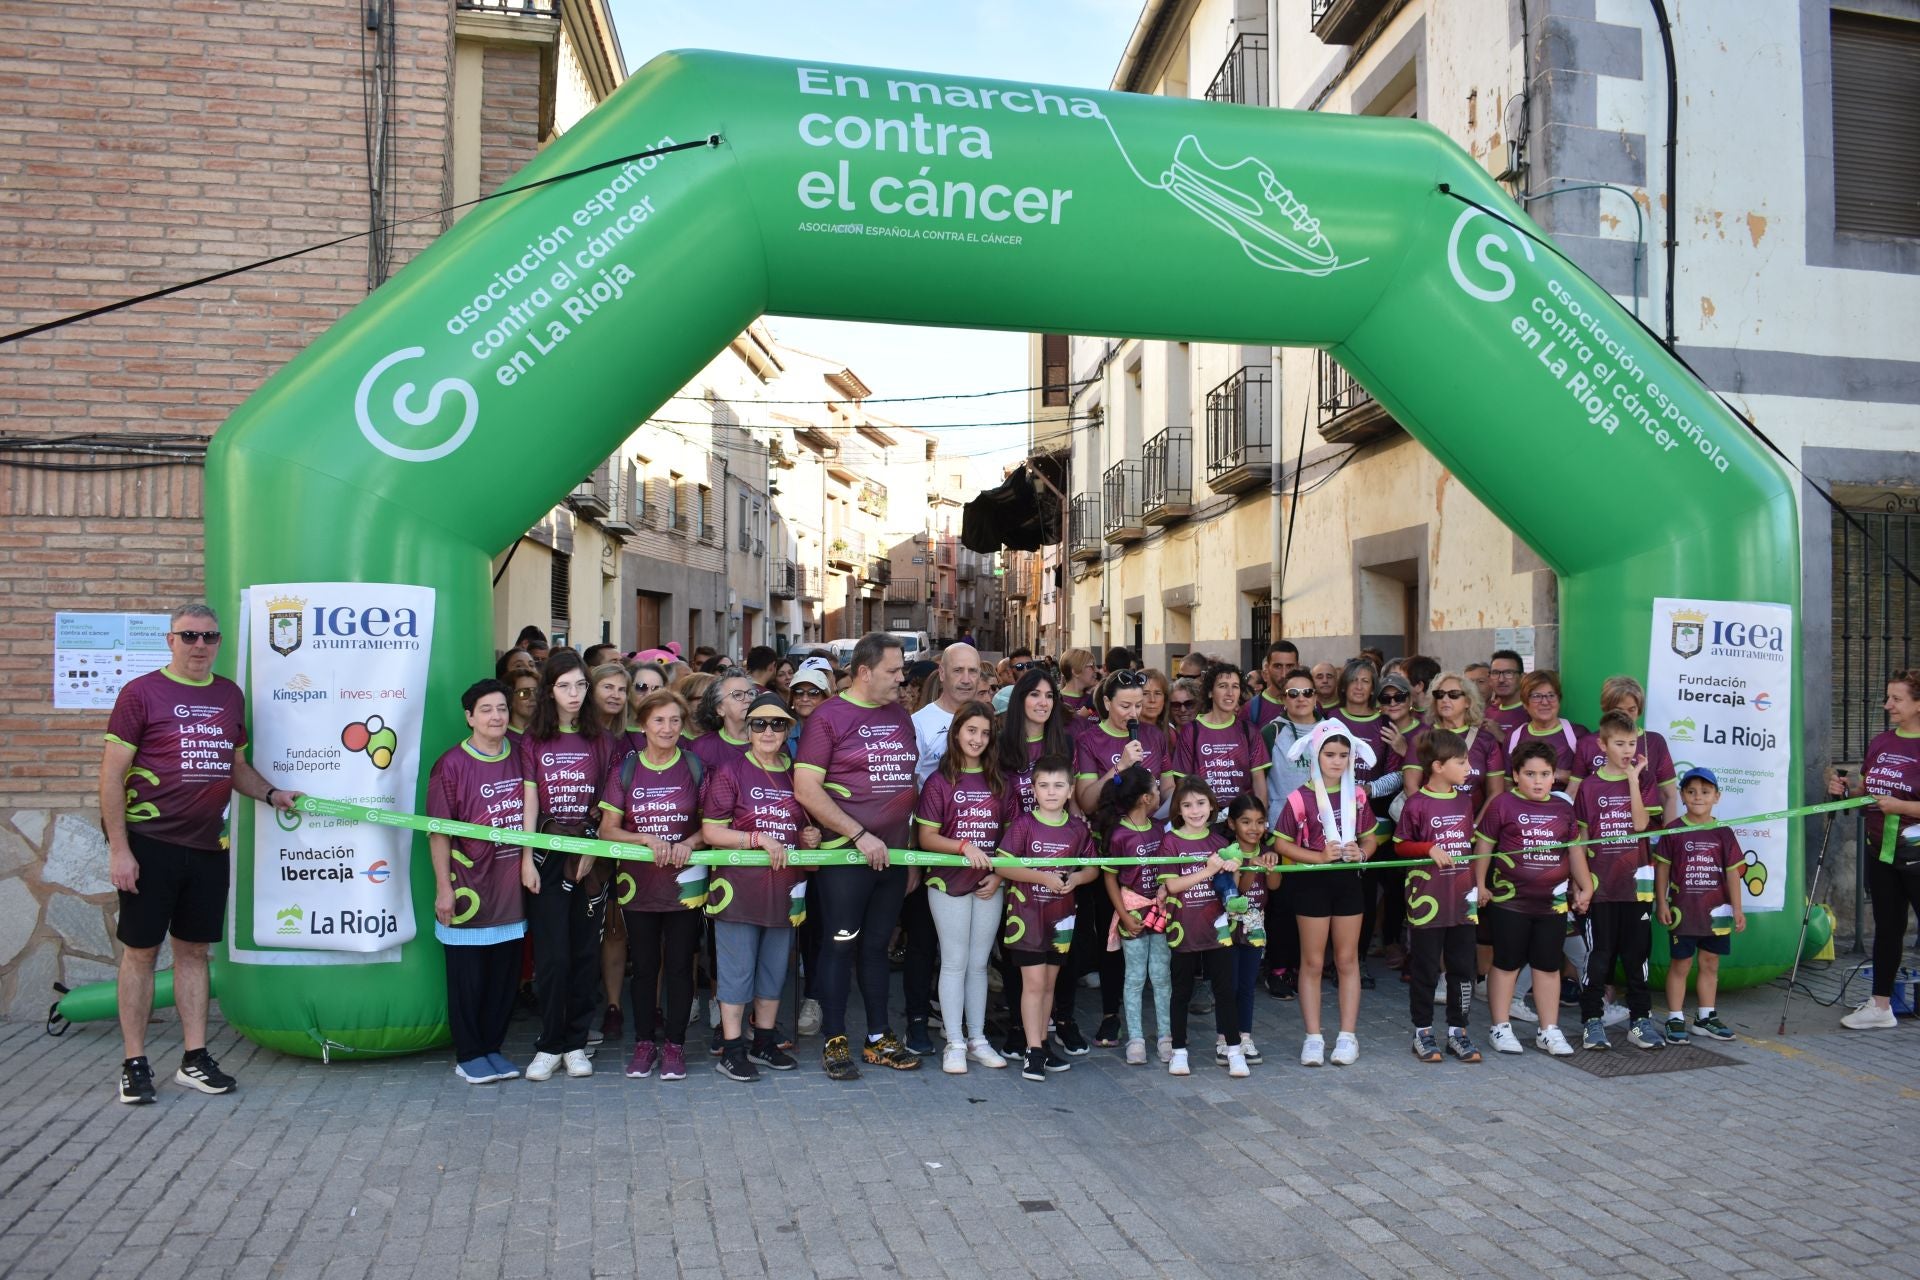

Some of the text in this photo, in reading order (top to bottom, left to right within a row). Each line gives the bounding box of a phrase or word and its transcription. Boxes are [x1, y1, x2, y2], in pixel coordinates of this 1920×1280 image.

[797, 66, 1104, 119] En marcha
[798, 112, 993, 160] contra
[798, 160, 1073, 225] el cáncer
[446, 135, 679, 335] asociación española
[798, 222, 1022, 245] ASOCIACIÓN ESPAÑOLA CONTRA EL CÁNCER
[471, 194, 656, 360] contra el cáncer
[496, 263, 636, 386] en La Rioja
[1511, 316, 1620, 435] en La Rioja
[1531, 297, 1679, 452] contra el cáncer
[1547, 279, 1730, 473] asociación española
[1679, 674, 1747, 688] Fundación
[273, 689, 327, 703] Kingspan
[1678, 688, 1746, 707] Ibercaja
[180, 724, 223, 736] La Rioja
[1703, 724, 1776, 751] La Rioja
[181, 738, 233, 749] En marcha
[865, 741, 903, 750] La Rioja
[181, 749, 219, 759] contra
[286, 745, 341, 758] Fundación
[868, 752, 916, 762] En marcha
[181, 759, 232, 770] el cáncer
[273, 761, 341, 772] Rioja Deporte
[869, 763, 900, 772] contra
[545, 770, 585, 781] La Rioja
[870, 772, 912, 781] el cáncer
[1880, 767, 1902, 778] Rioja
[1020, 777, 1032, 785] La
[1866, 776, 1912, 792] En marcha
[548, 784, 595, 794] En marcha
[550, 794, 576, 804] contra
[487, 798, 524, 814] La Rioja
[558, 804, 588, 812] cáncer
[632, 801, 676, 812] La Rioja
[754, 805, 790, 818] La Rioja
[634, 813, 689, 823] En marcha
[970, 808, 992, 818] Rioja
[1611, 811, 1632, 819] Rioja
[491, 816, 503, 827] En
[756, 819, 768, 828] En
[970, 821, 998, 829] marcha
[1600, 822, 1611, 830] En
[638, 823, 669, 832] contra
[1601, 829, 1627, 837] contra
[956, 830, 985, 838] contra
[1446, 830, 1464, 839] Rioja
[1534, 829, 1553, 838] Rioja
[280, 846, 354, 860] Fundación
[1522, 852, 1532, 860] el
[1696, 855, 1713, 863] Rioja
[281, 863, 354, 883] Ibercaja
[310, 909, 398, 937] La Rioja
